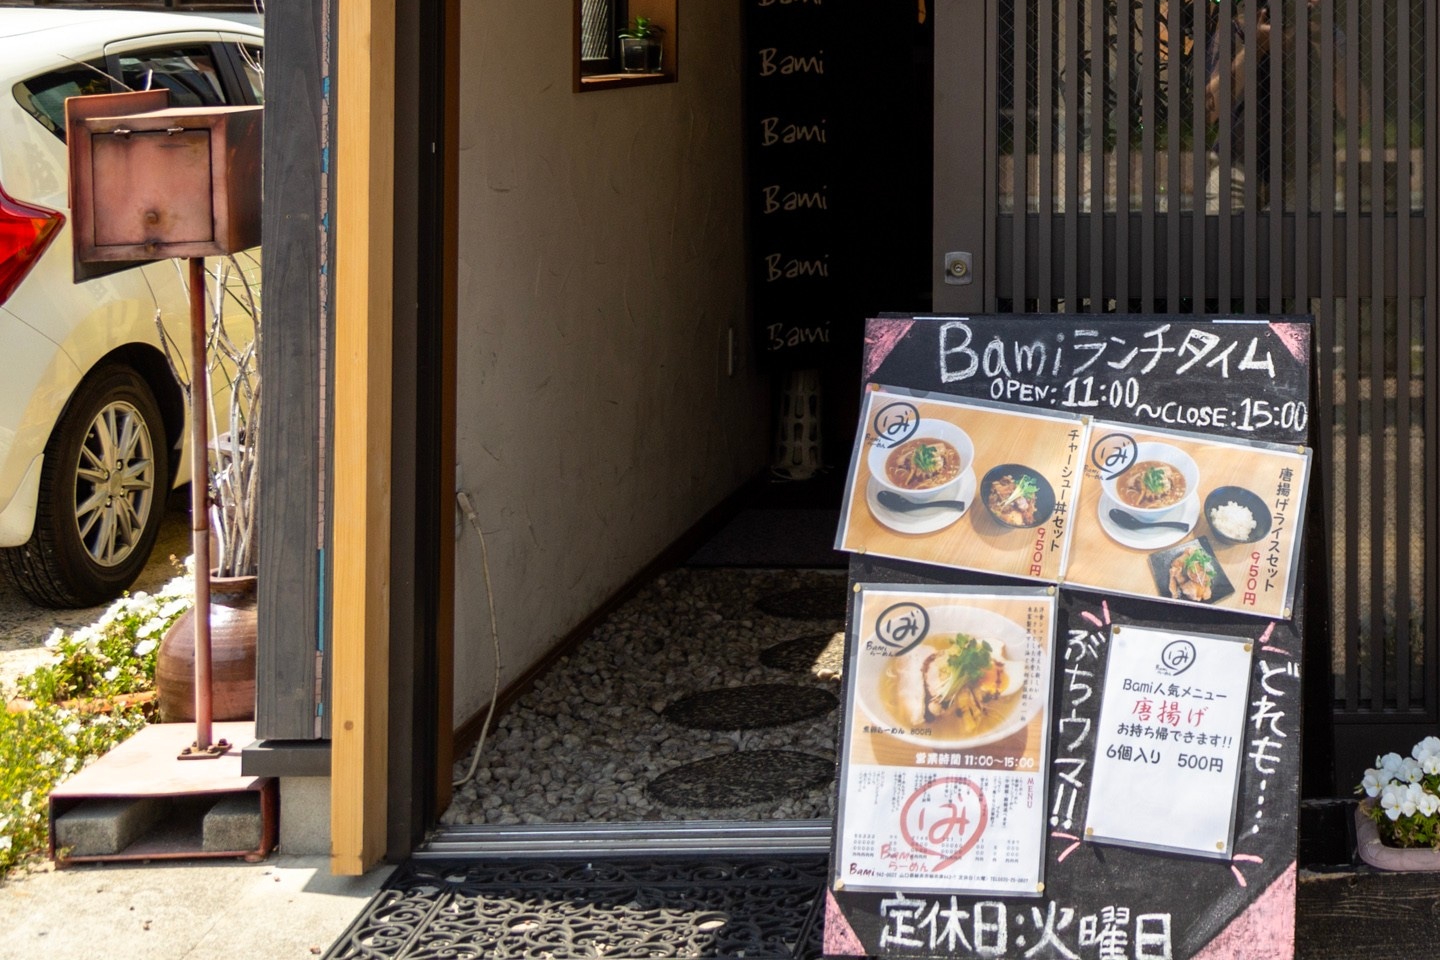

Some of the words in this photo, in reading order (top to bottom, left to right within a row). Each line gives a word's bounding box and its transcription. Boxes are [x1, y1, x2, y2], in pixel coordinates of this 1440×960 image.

[759, 47, 824, 76] Bami
[761, 116, 826, 146] Bami
[763, 185, 828, 214] Bami
[765, 253, 829, 282] Bami
[767, 321, 831, 351] Bami
[1050, 429, 1080, 552] チャーシュー丼セット
[1265, 467, 1294, 593] 唐揚げライスセット
[1029, 527, 1046, 577] 950円
[1243, 551, 1261, 606] 950円
[1132, 697, 1208, 727] 唐揚げ
[915, 752, 961, 766] 営業時間
[1106, 743, 1161, 764] 6個入り
[1177, 752, 1224, 773] 500円
[1026, 777, 1035, 809] MENU
[849, 862, 875, 877] Bami
[888, 862, 929, 872] らーめん
